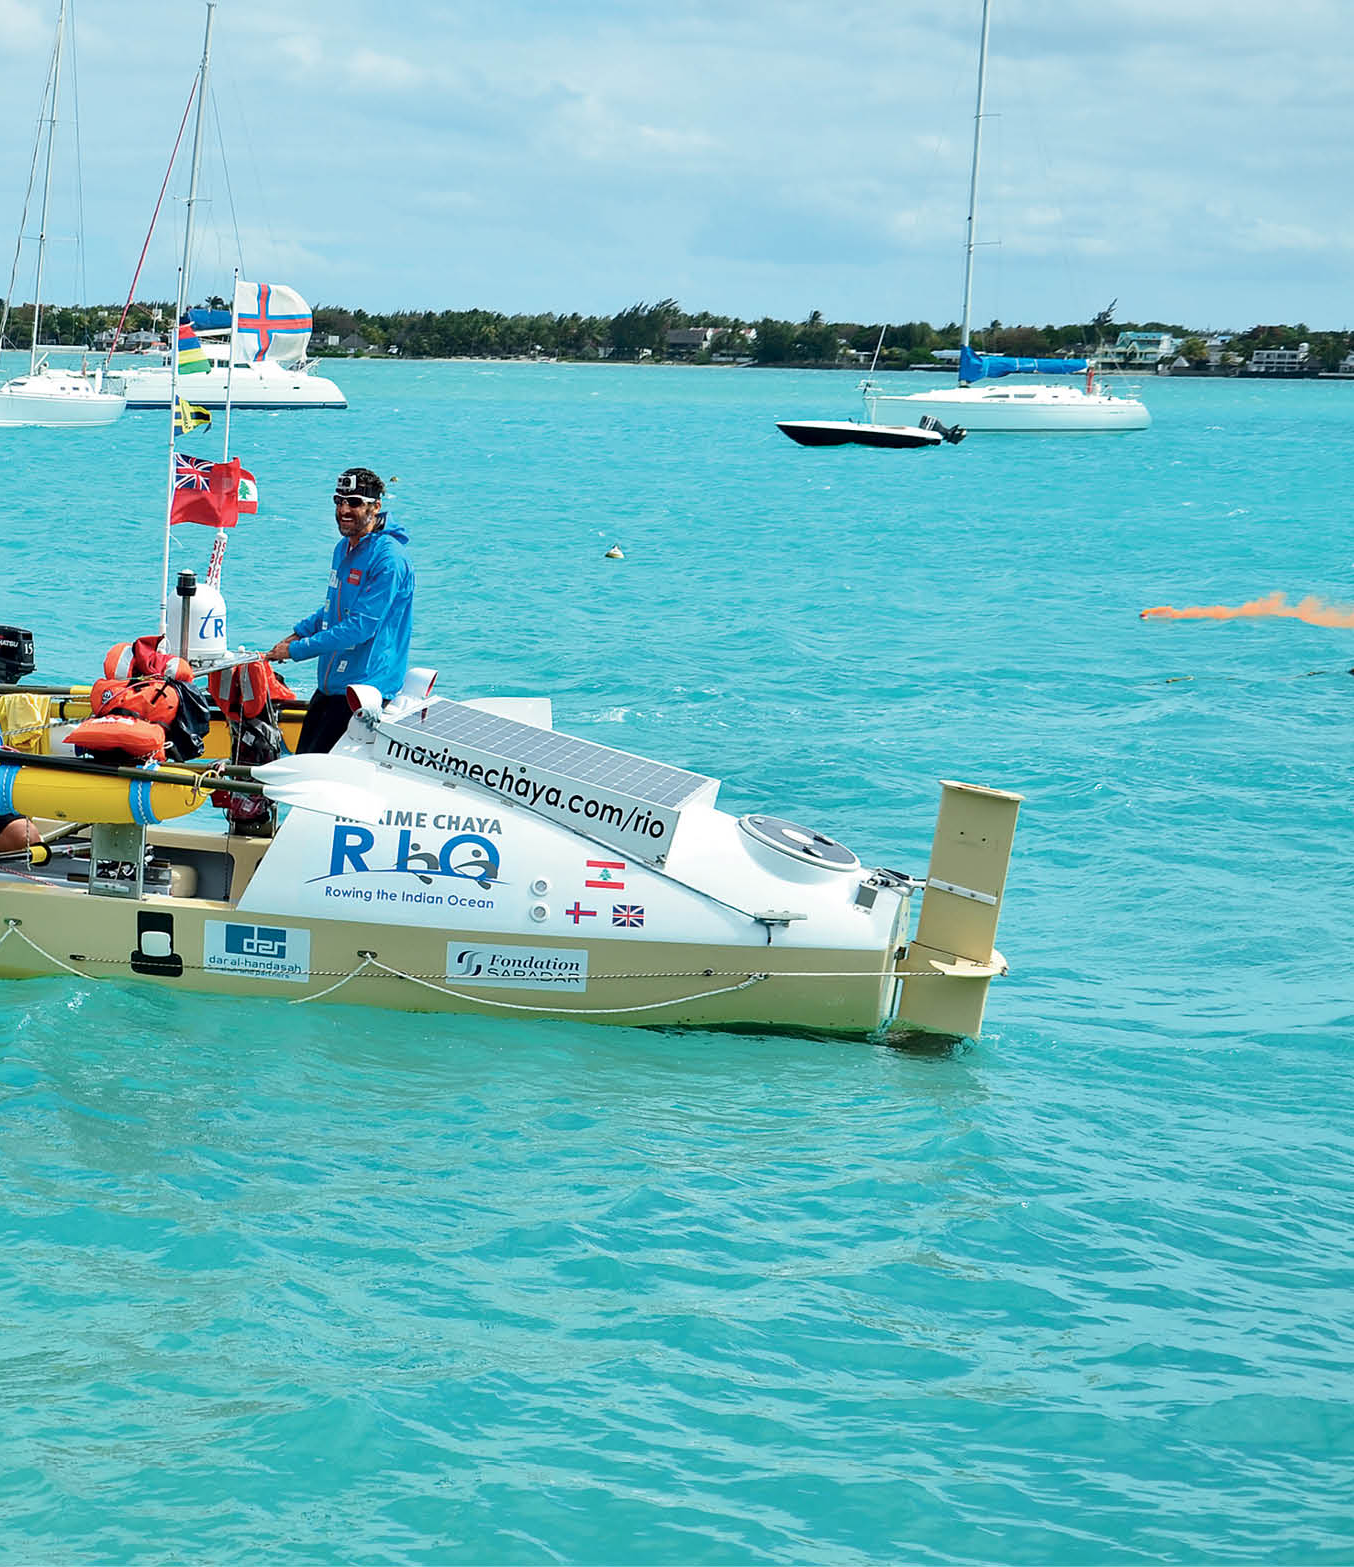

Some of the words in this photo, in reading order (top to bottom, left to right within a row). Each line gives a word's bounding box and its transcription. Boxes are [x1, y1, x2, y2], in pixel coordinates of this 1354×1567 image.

[24, 643, 33, 655] 15
[386, 738, 665, 840] maximechaya.com/rio
[432, 814, 503, 835] CHAYA
[325, 886, 373, 902] Rowing
[377, 889, 398, 902] the
[401, 891, 444, 905] Indian
[447, 894, 494, 909] Ocean
[209, 955, 229, 964] dar
[230, 958, 302, 974] al-handasah
[490, 954, 580, 971] Fondation
